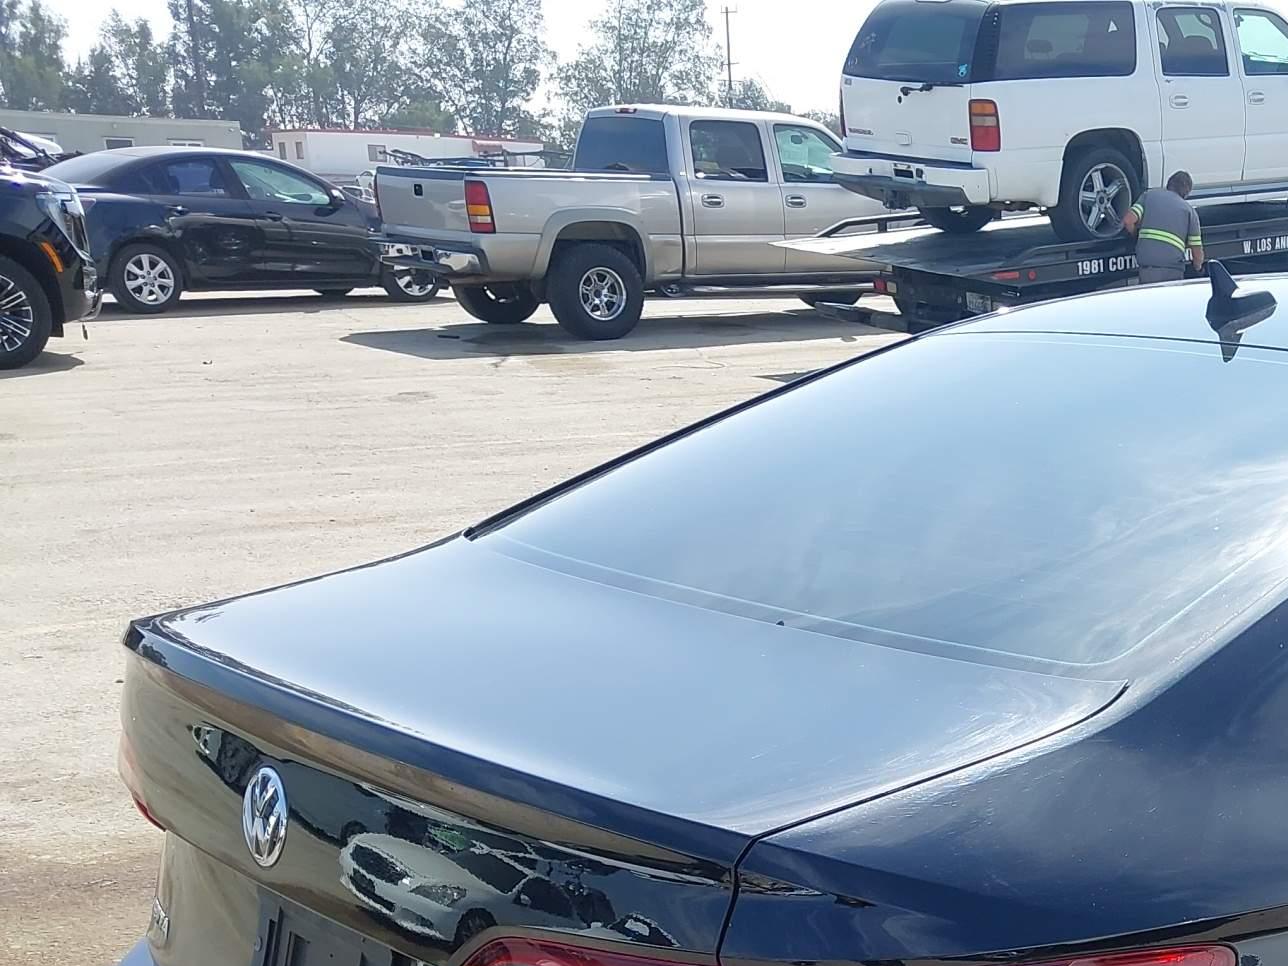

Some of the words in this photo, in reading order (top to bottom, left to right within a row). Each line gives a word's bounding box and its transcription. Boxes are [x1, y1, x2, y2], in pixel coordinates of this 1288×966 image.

[1243, 240, 1255, 254] W.
[1256, 237, 1272, 253] LOS
[1077, 258, 1105, 276] 1981
